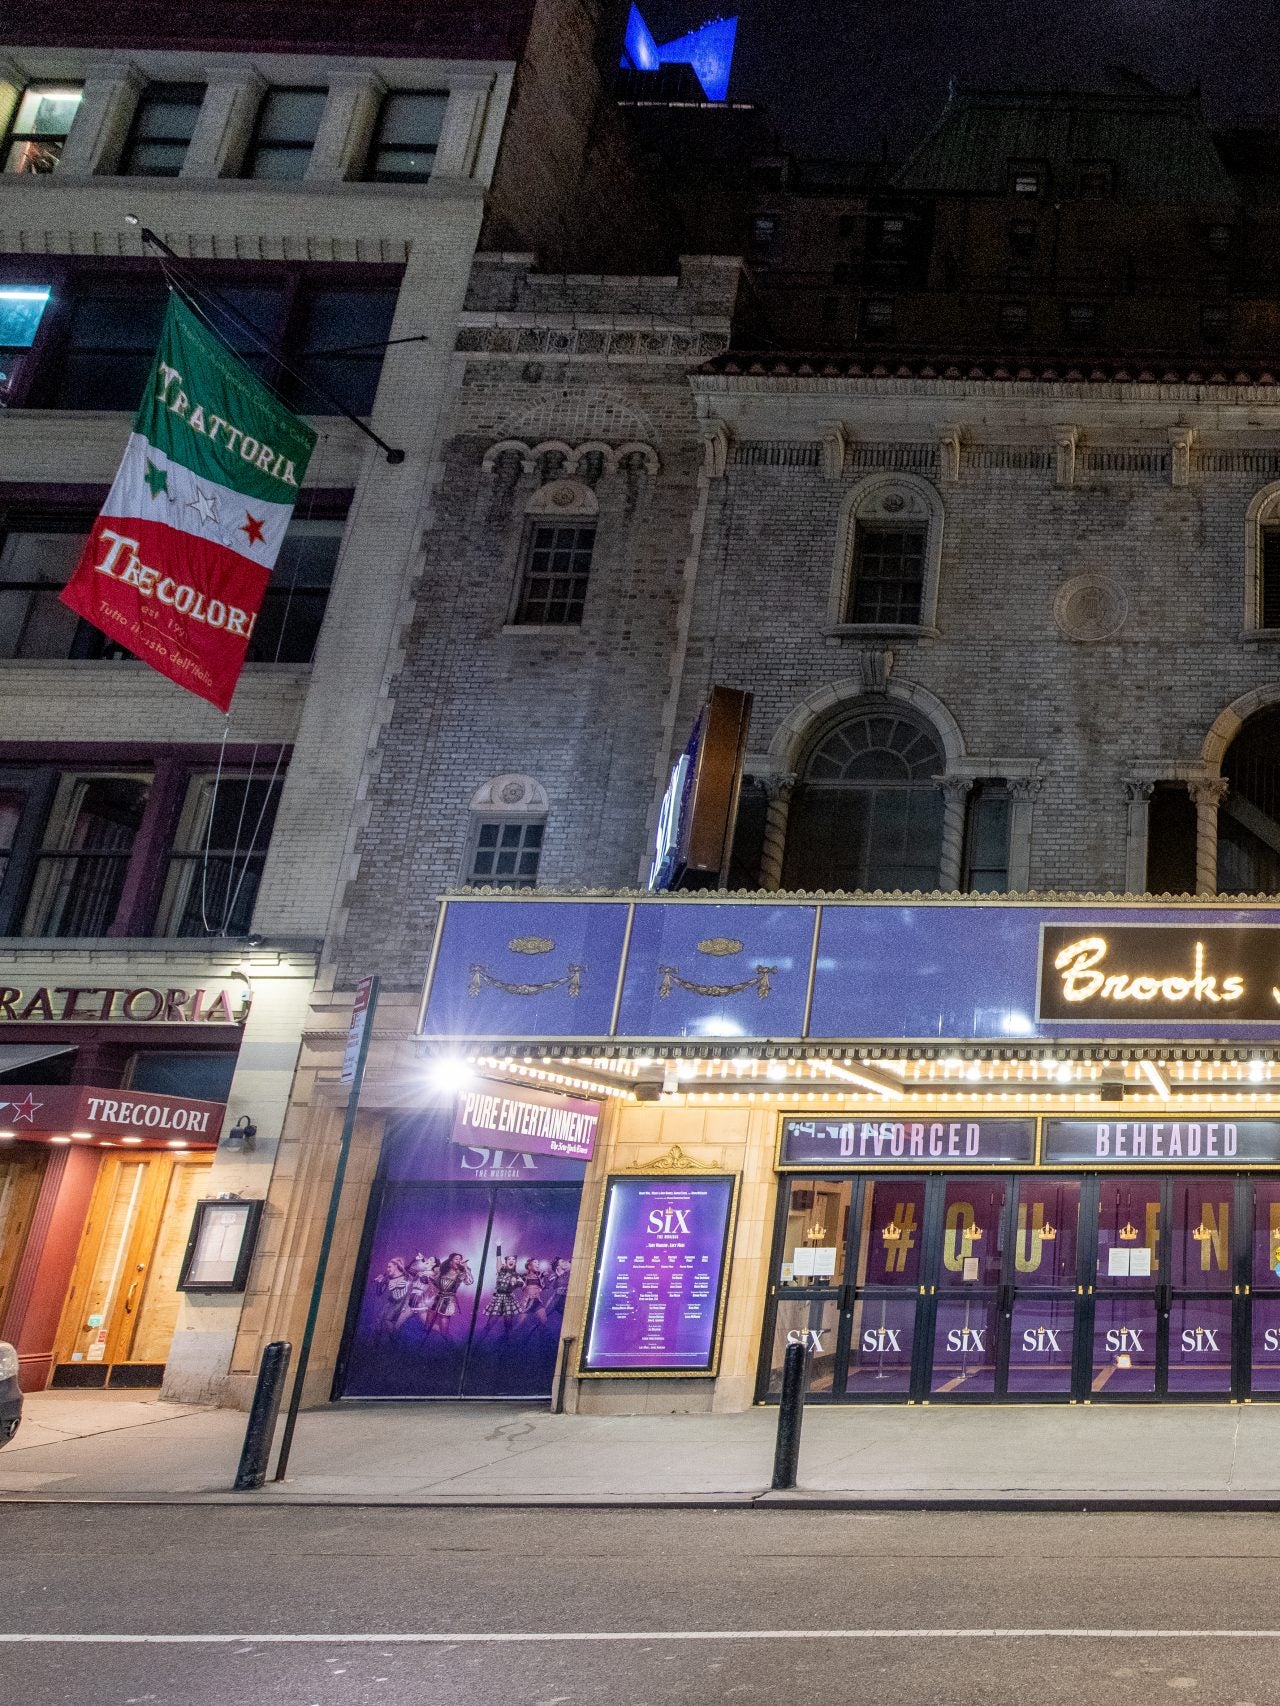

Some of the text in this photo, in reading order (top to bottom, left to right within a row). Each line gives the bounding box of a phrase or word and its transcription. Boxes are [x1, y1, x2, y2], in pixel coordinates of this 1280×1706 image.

[158, 361, 299, 487] TRATTORIA
[95, 529, 257, 639] TRECOLORI
[100, 601, 128, 625] Tutto
[1054, 937, 1244, 1002] Brooks
[87, 1098, 210, 1132] TRECOLORI
[459, 1091, 598, 1144] "PURE ENTERTAINMENT!"
[840, 1123, 980, 1156] DIVORCED
[1096, 1123, 1238, 1156] BEHEADED
[646, 1209, 691, 1234] SIX
[862, 1329, 901, 1352] SIX
[946, 1329, 985, 1352] SIX
[1022, 1329, 1061, 1352] SIX
[1105, 1329, 1144, 1352] SIX
[1181, 1329, 1220, 1352] SIX
